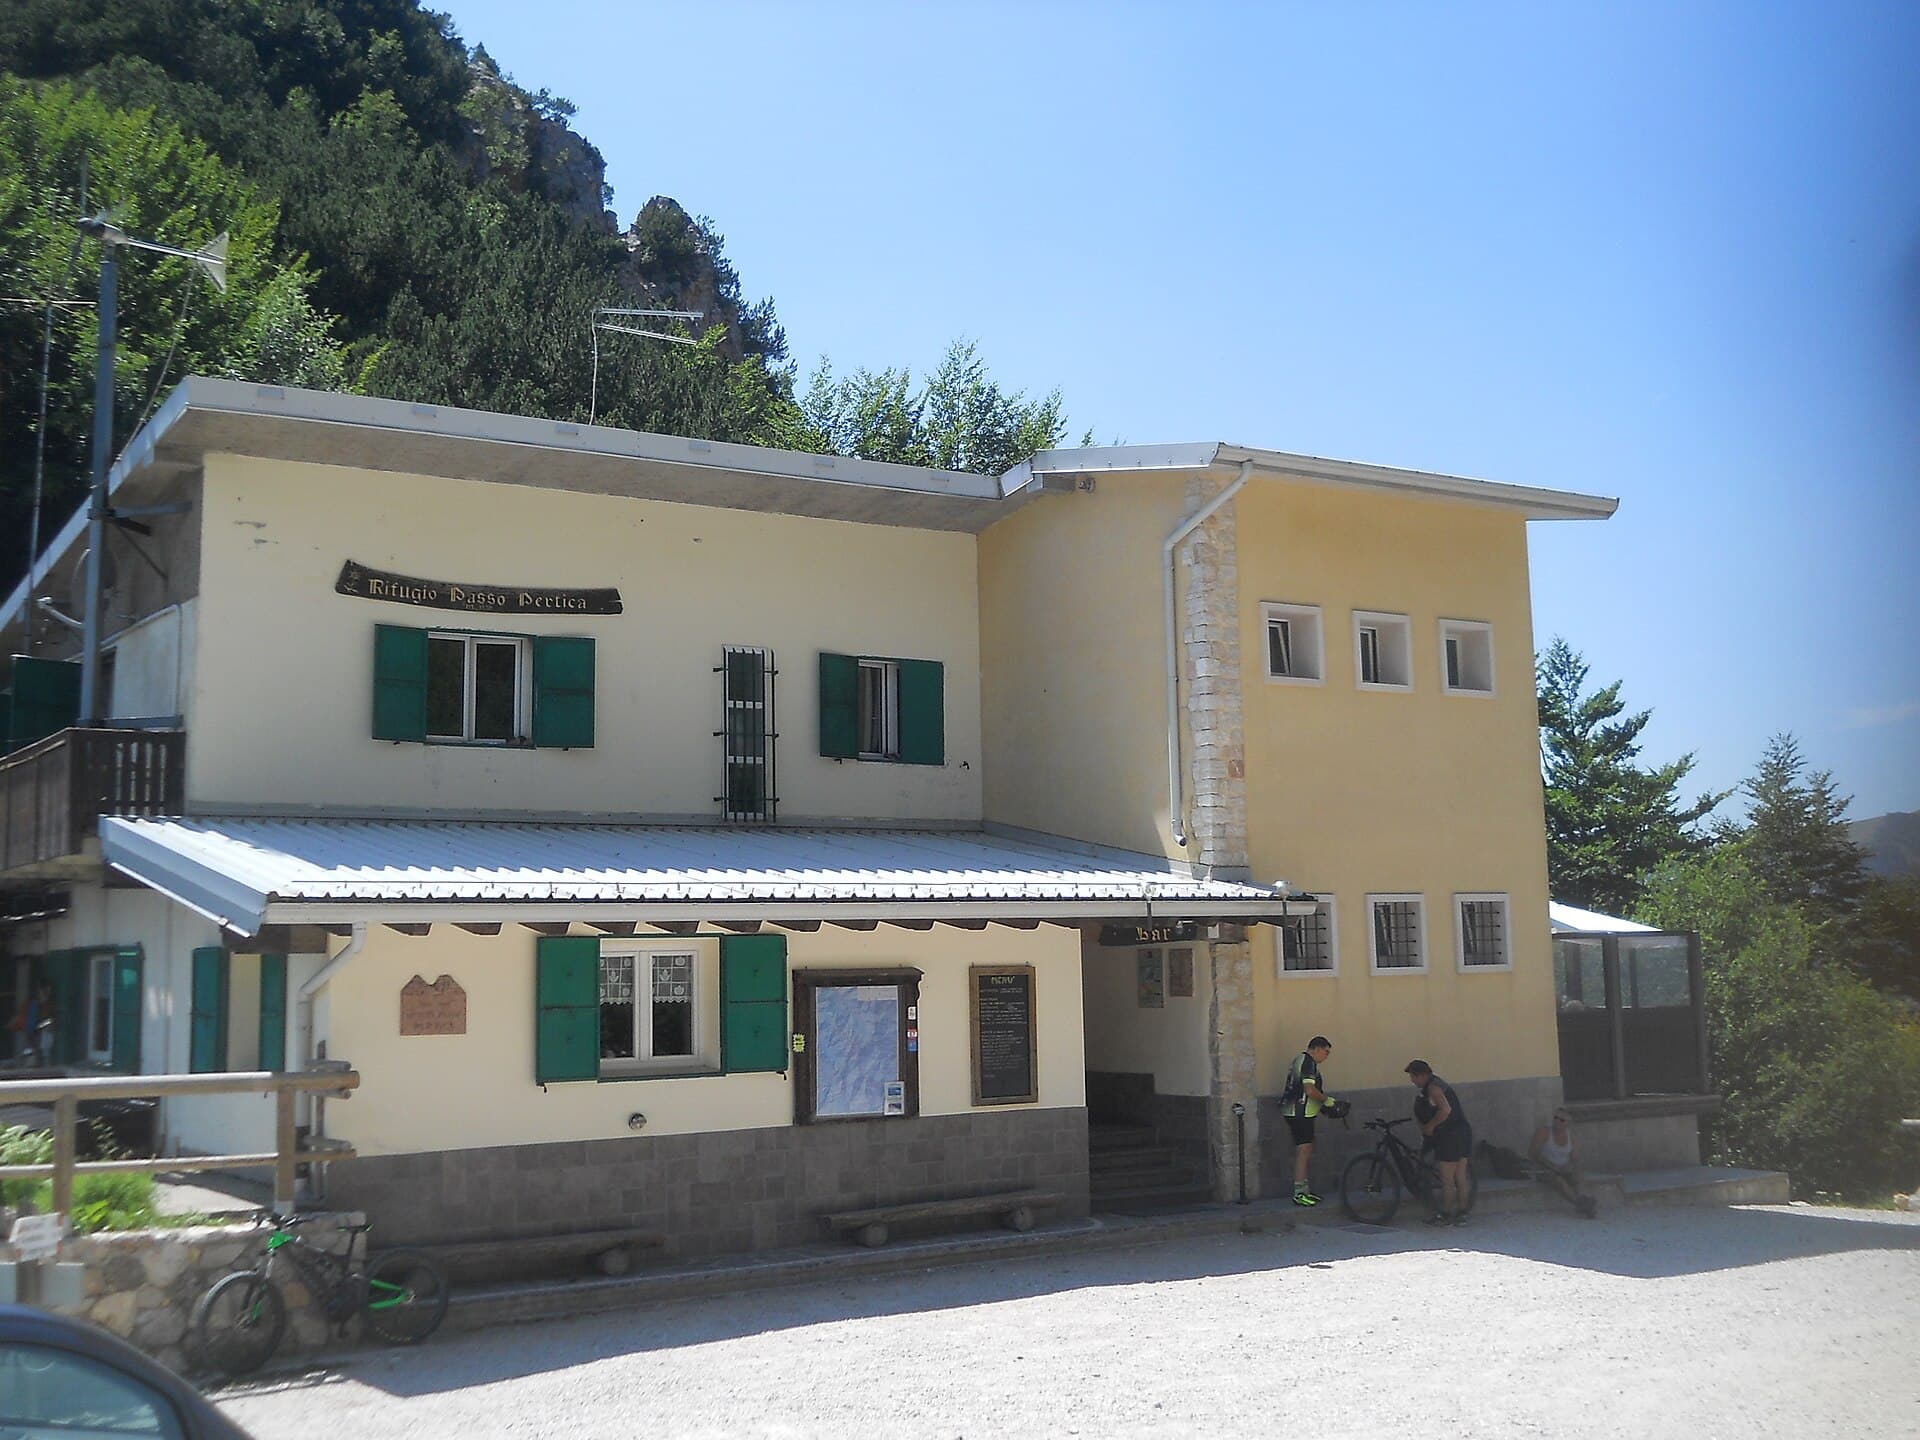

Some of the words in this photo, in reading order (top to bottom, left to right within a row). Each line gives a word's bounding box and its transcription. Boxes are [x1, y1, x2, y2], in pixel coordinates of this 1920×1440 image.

[369, 578, 437, 604] Rifugio
[450, 586, 506, 606] Passo
[519, 592, 587, 610] Pertica
